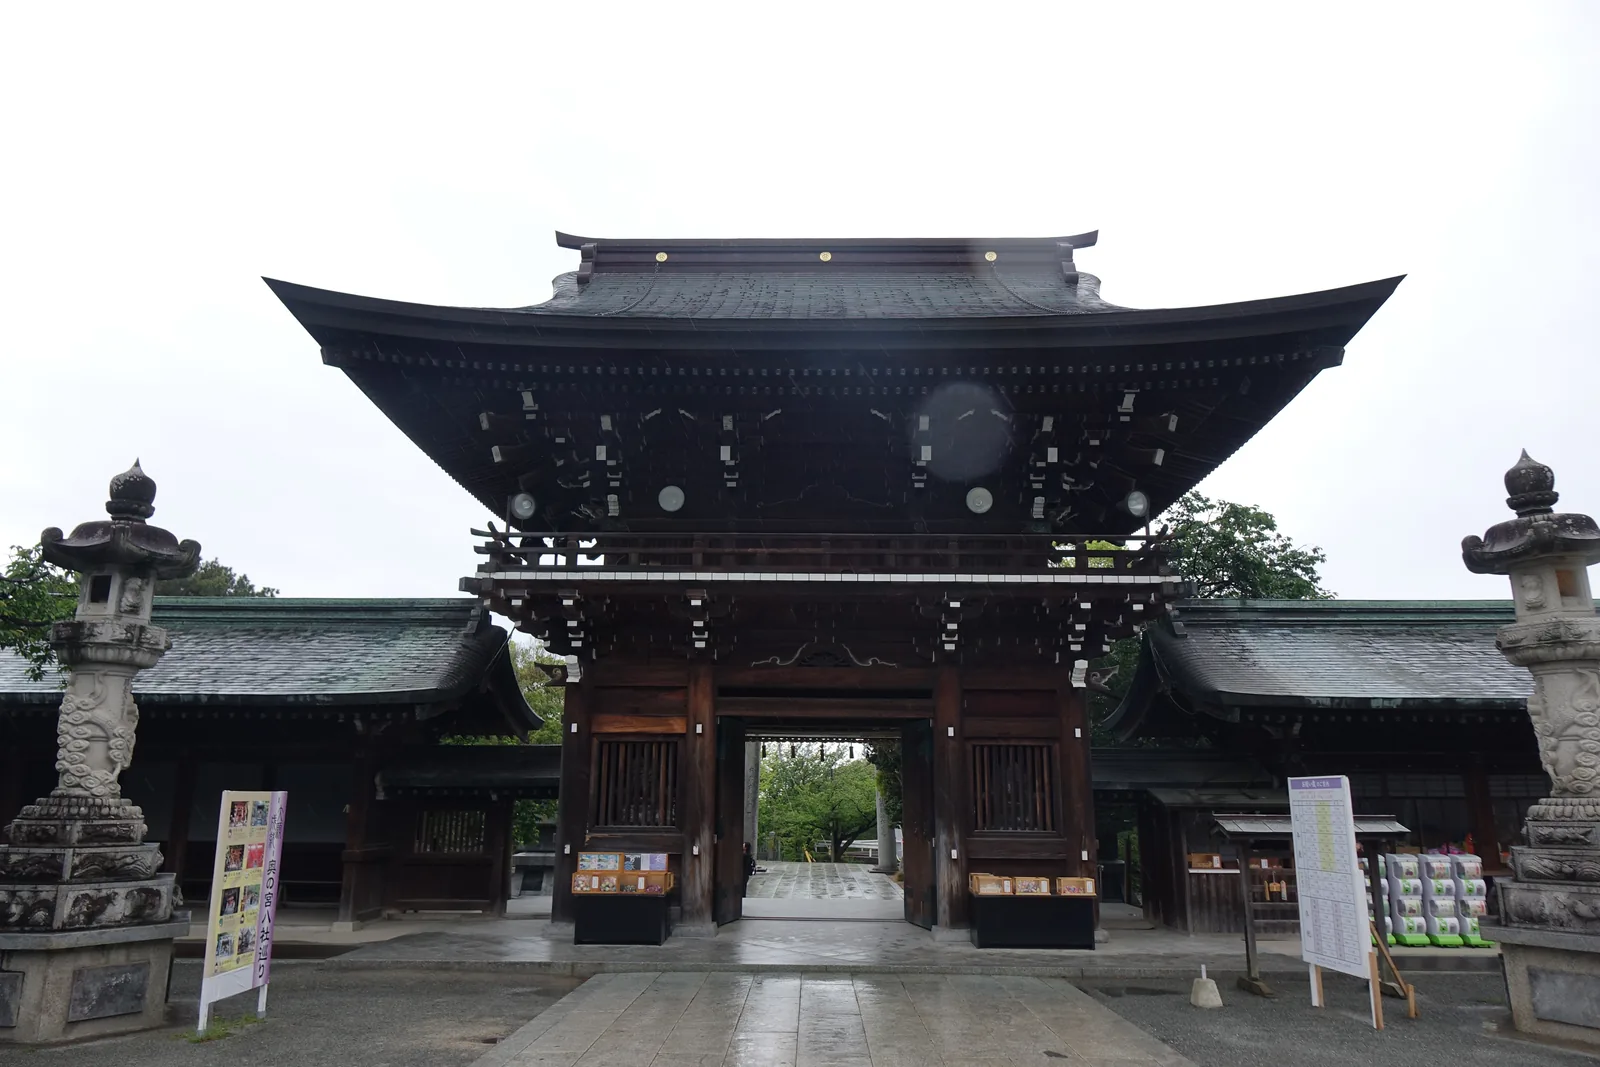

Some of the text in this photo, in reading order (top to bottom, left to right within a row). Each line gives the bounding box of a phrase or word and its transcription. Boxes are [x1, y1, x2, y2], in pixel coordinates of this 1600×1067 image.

[258, 859, 277, 978] 奥の宮八社巡り
